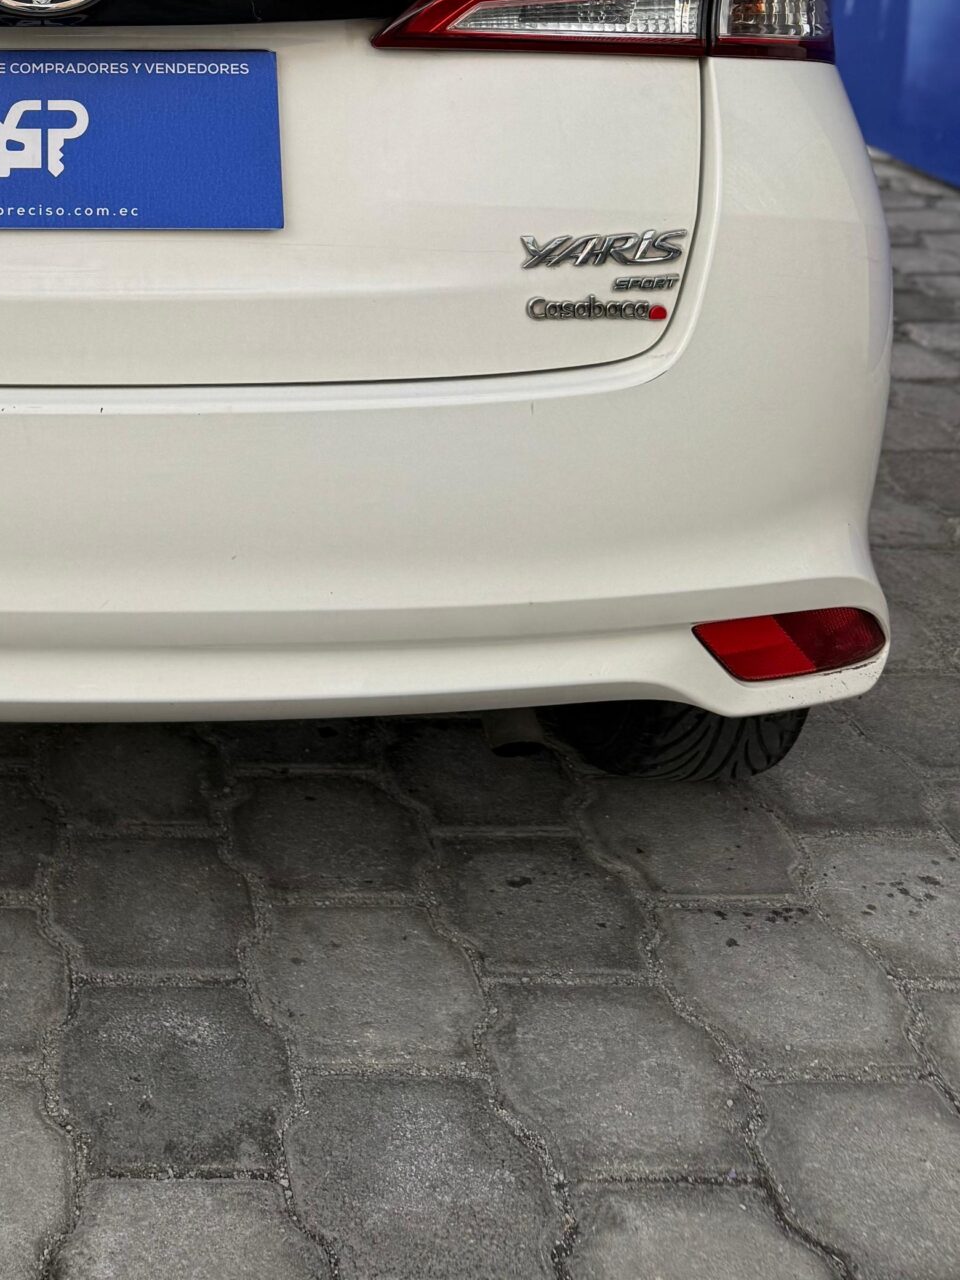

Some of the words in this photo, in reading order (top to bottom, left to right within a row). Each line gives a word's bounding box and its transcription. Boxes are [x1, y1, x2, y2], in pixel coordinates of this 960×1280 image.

[9, 62, 129, 74] COMPRADORES
[131, 62, 142, 74] Y
[145, 62, 250, 75] VENDEDORES
[612, 273, 680, 293] SPORT
[526, 294, 651, 321] Casabaca
